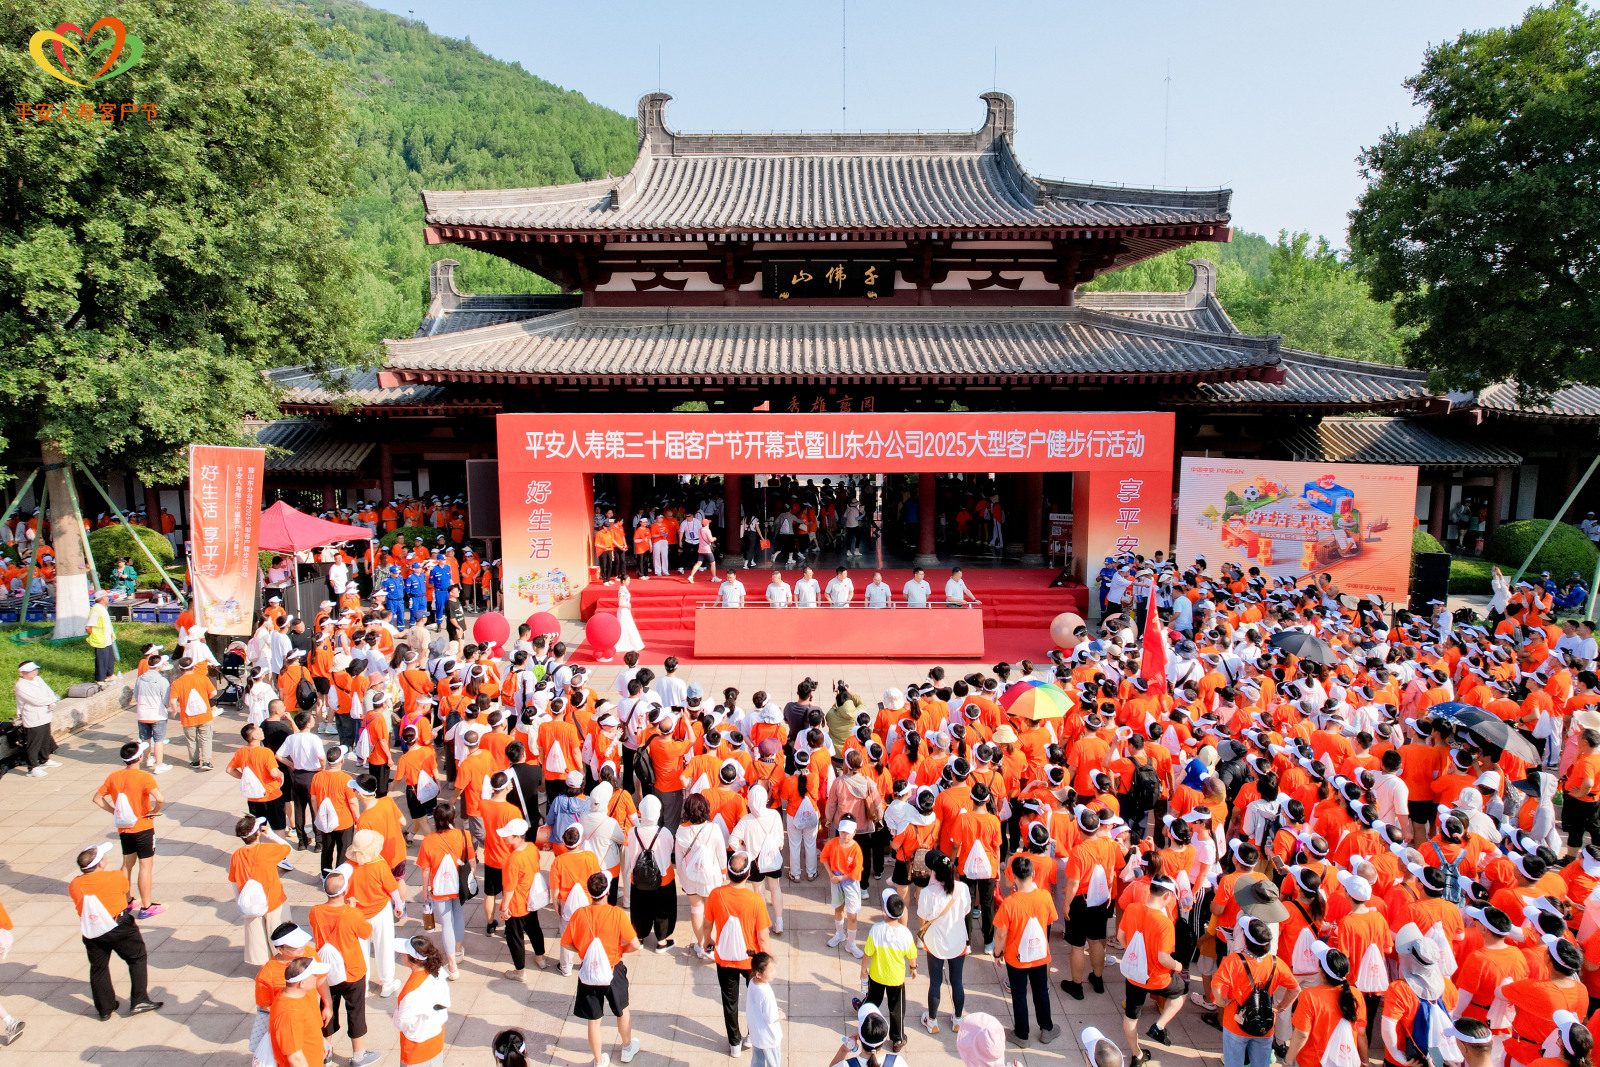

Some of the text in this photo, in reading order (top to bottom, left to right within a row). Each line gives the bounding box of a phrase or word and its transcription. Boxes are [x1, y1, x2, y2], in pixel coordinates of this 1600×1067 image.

[525, 429, 1145, 460] 平安人寿第三十届客户节开幕式暨山东分公司2025大型客户健步行活动
[200, 464, 220, 578] 好生活 享平安
[525, 480, 553, 560] 好生活
[1114, 478, 1144, 558] 享平安
[1246, 509, 1288, 528] 好生活
